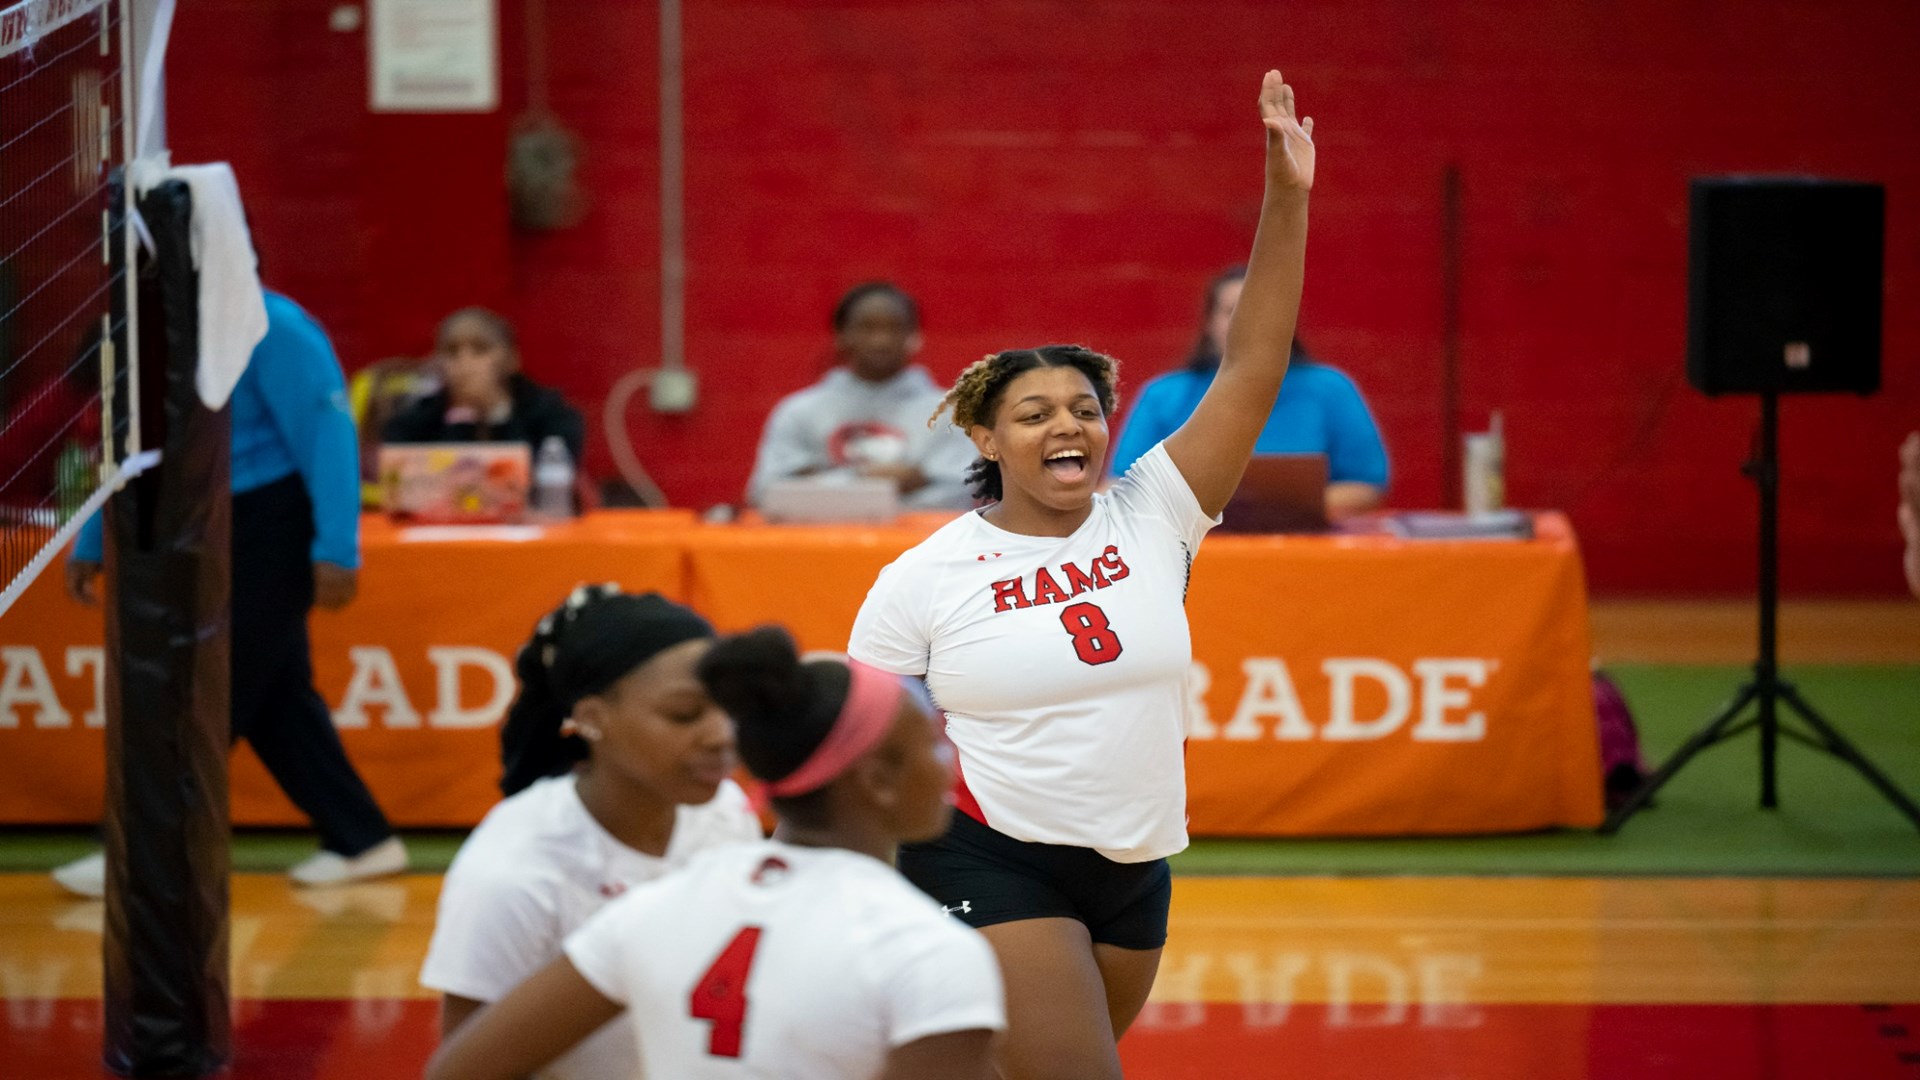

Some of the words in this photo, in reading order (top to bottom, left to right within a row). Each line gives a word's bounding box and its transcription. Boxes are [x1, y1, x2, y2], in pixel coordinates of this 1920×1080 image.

[991, 545, 1130, 613] HAMS
[1059, 601, 1124, 666] 8
[690, 924, 763, 1060] 4
